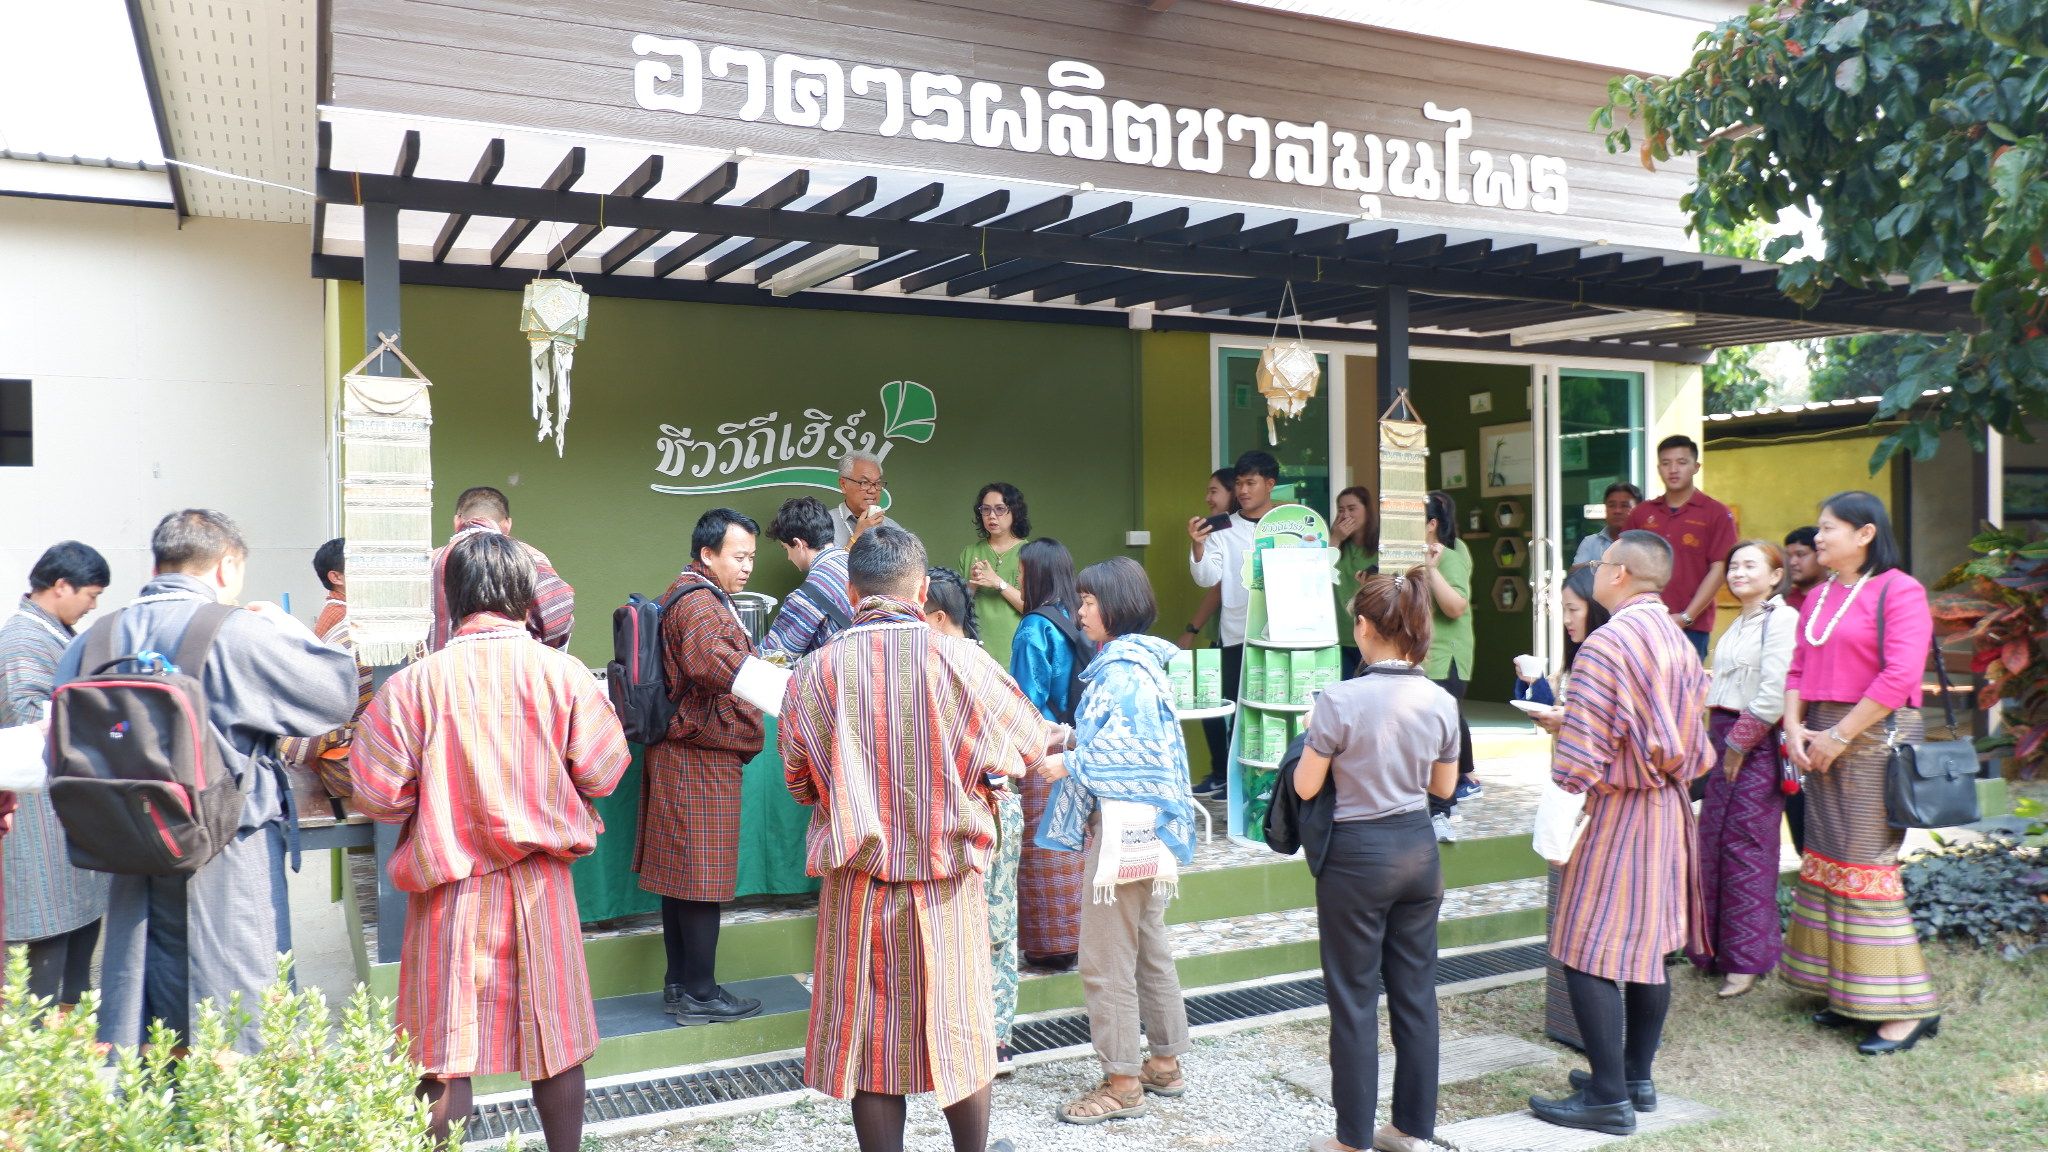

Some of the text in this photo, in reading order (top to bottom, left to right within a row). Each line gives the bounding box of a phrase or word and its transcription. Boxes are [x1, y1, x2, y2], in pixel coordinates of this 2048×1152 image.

[632, 34, 1569, 218] อาคารผลิตชาสมุนไพร
